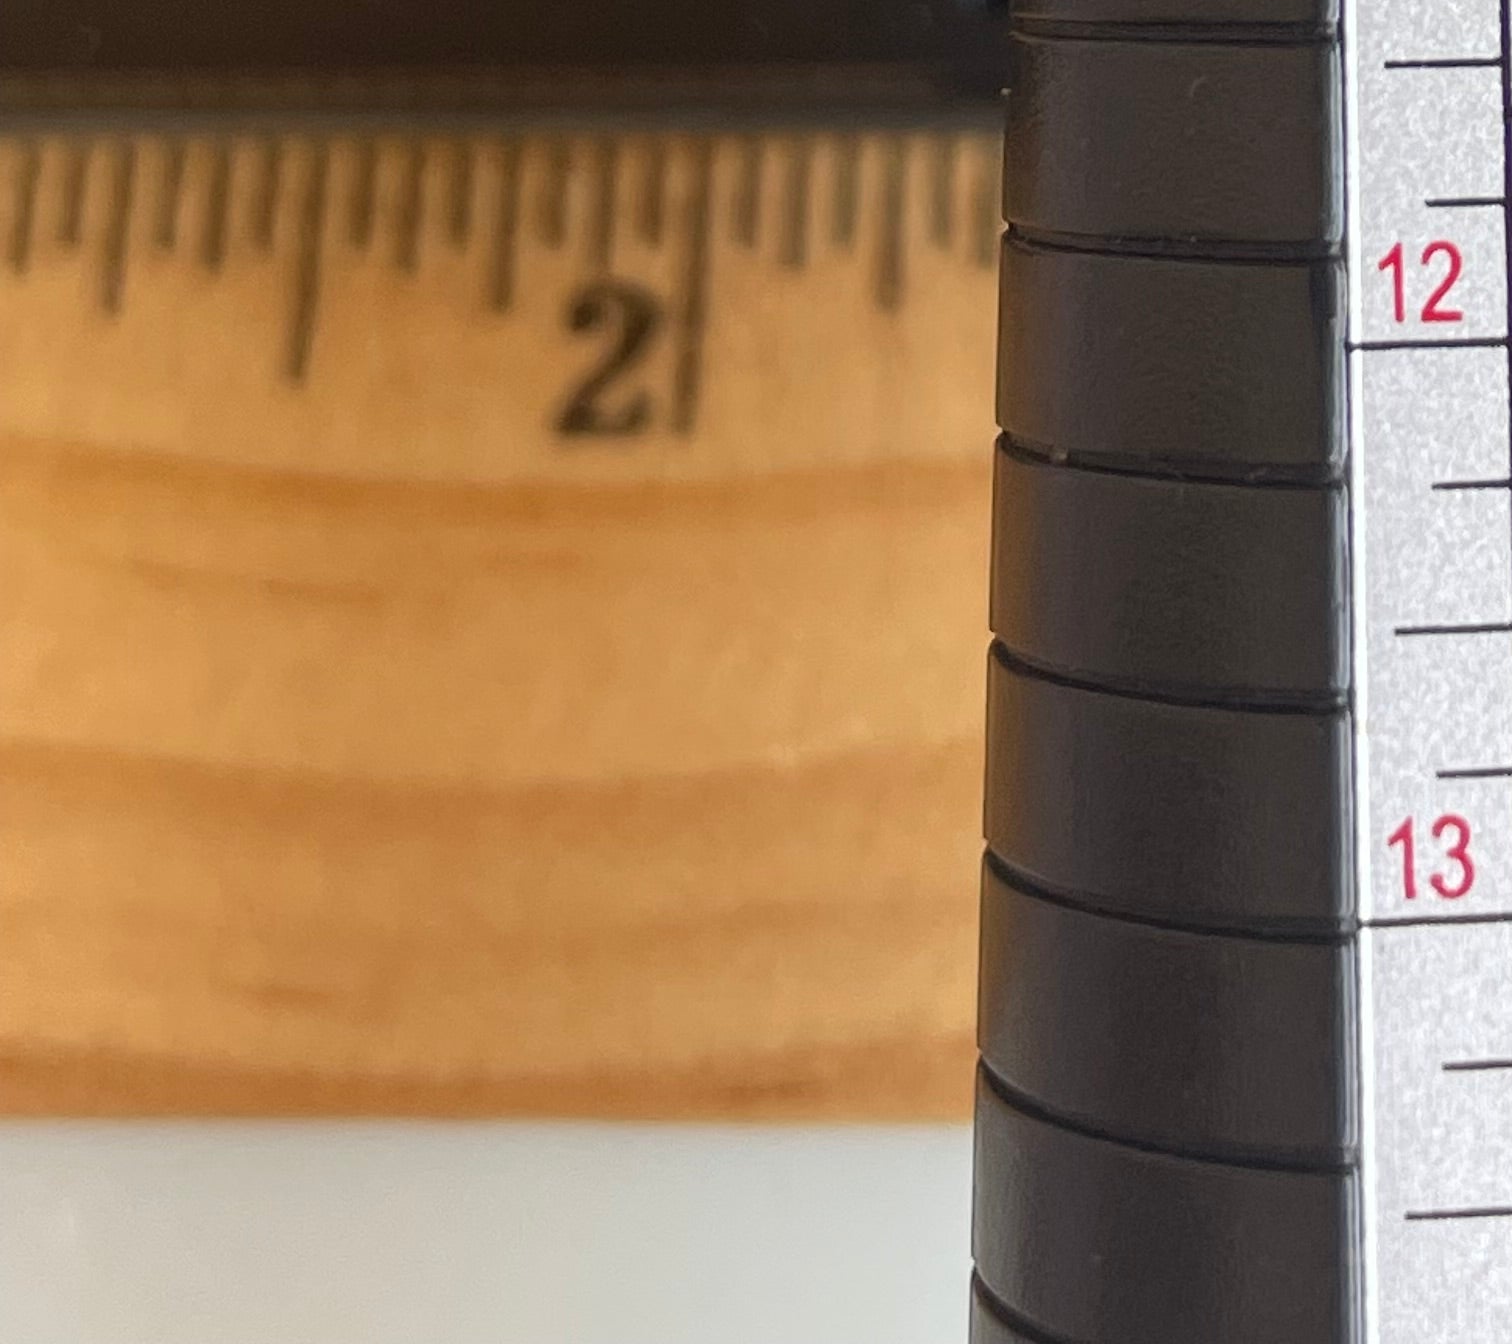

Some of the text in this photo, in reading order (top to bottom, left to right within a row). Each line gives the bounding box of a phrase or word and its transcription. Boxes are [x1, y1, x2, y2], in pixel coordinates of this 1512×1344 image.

[1376, 238, 1465, 325] 12
[553, 278, 663, 442] 2
[1386, 812, 1477, 901] 13
